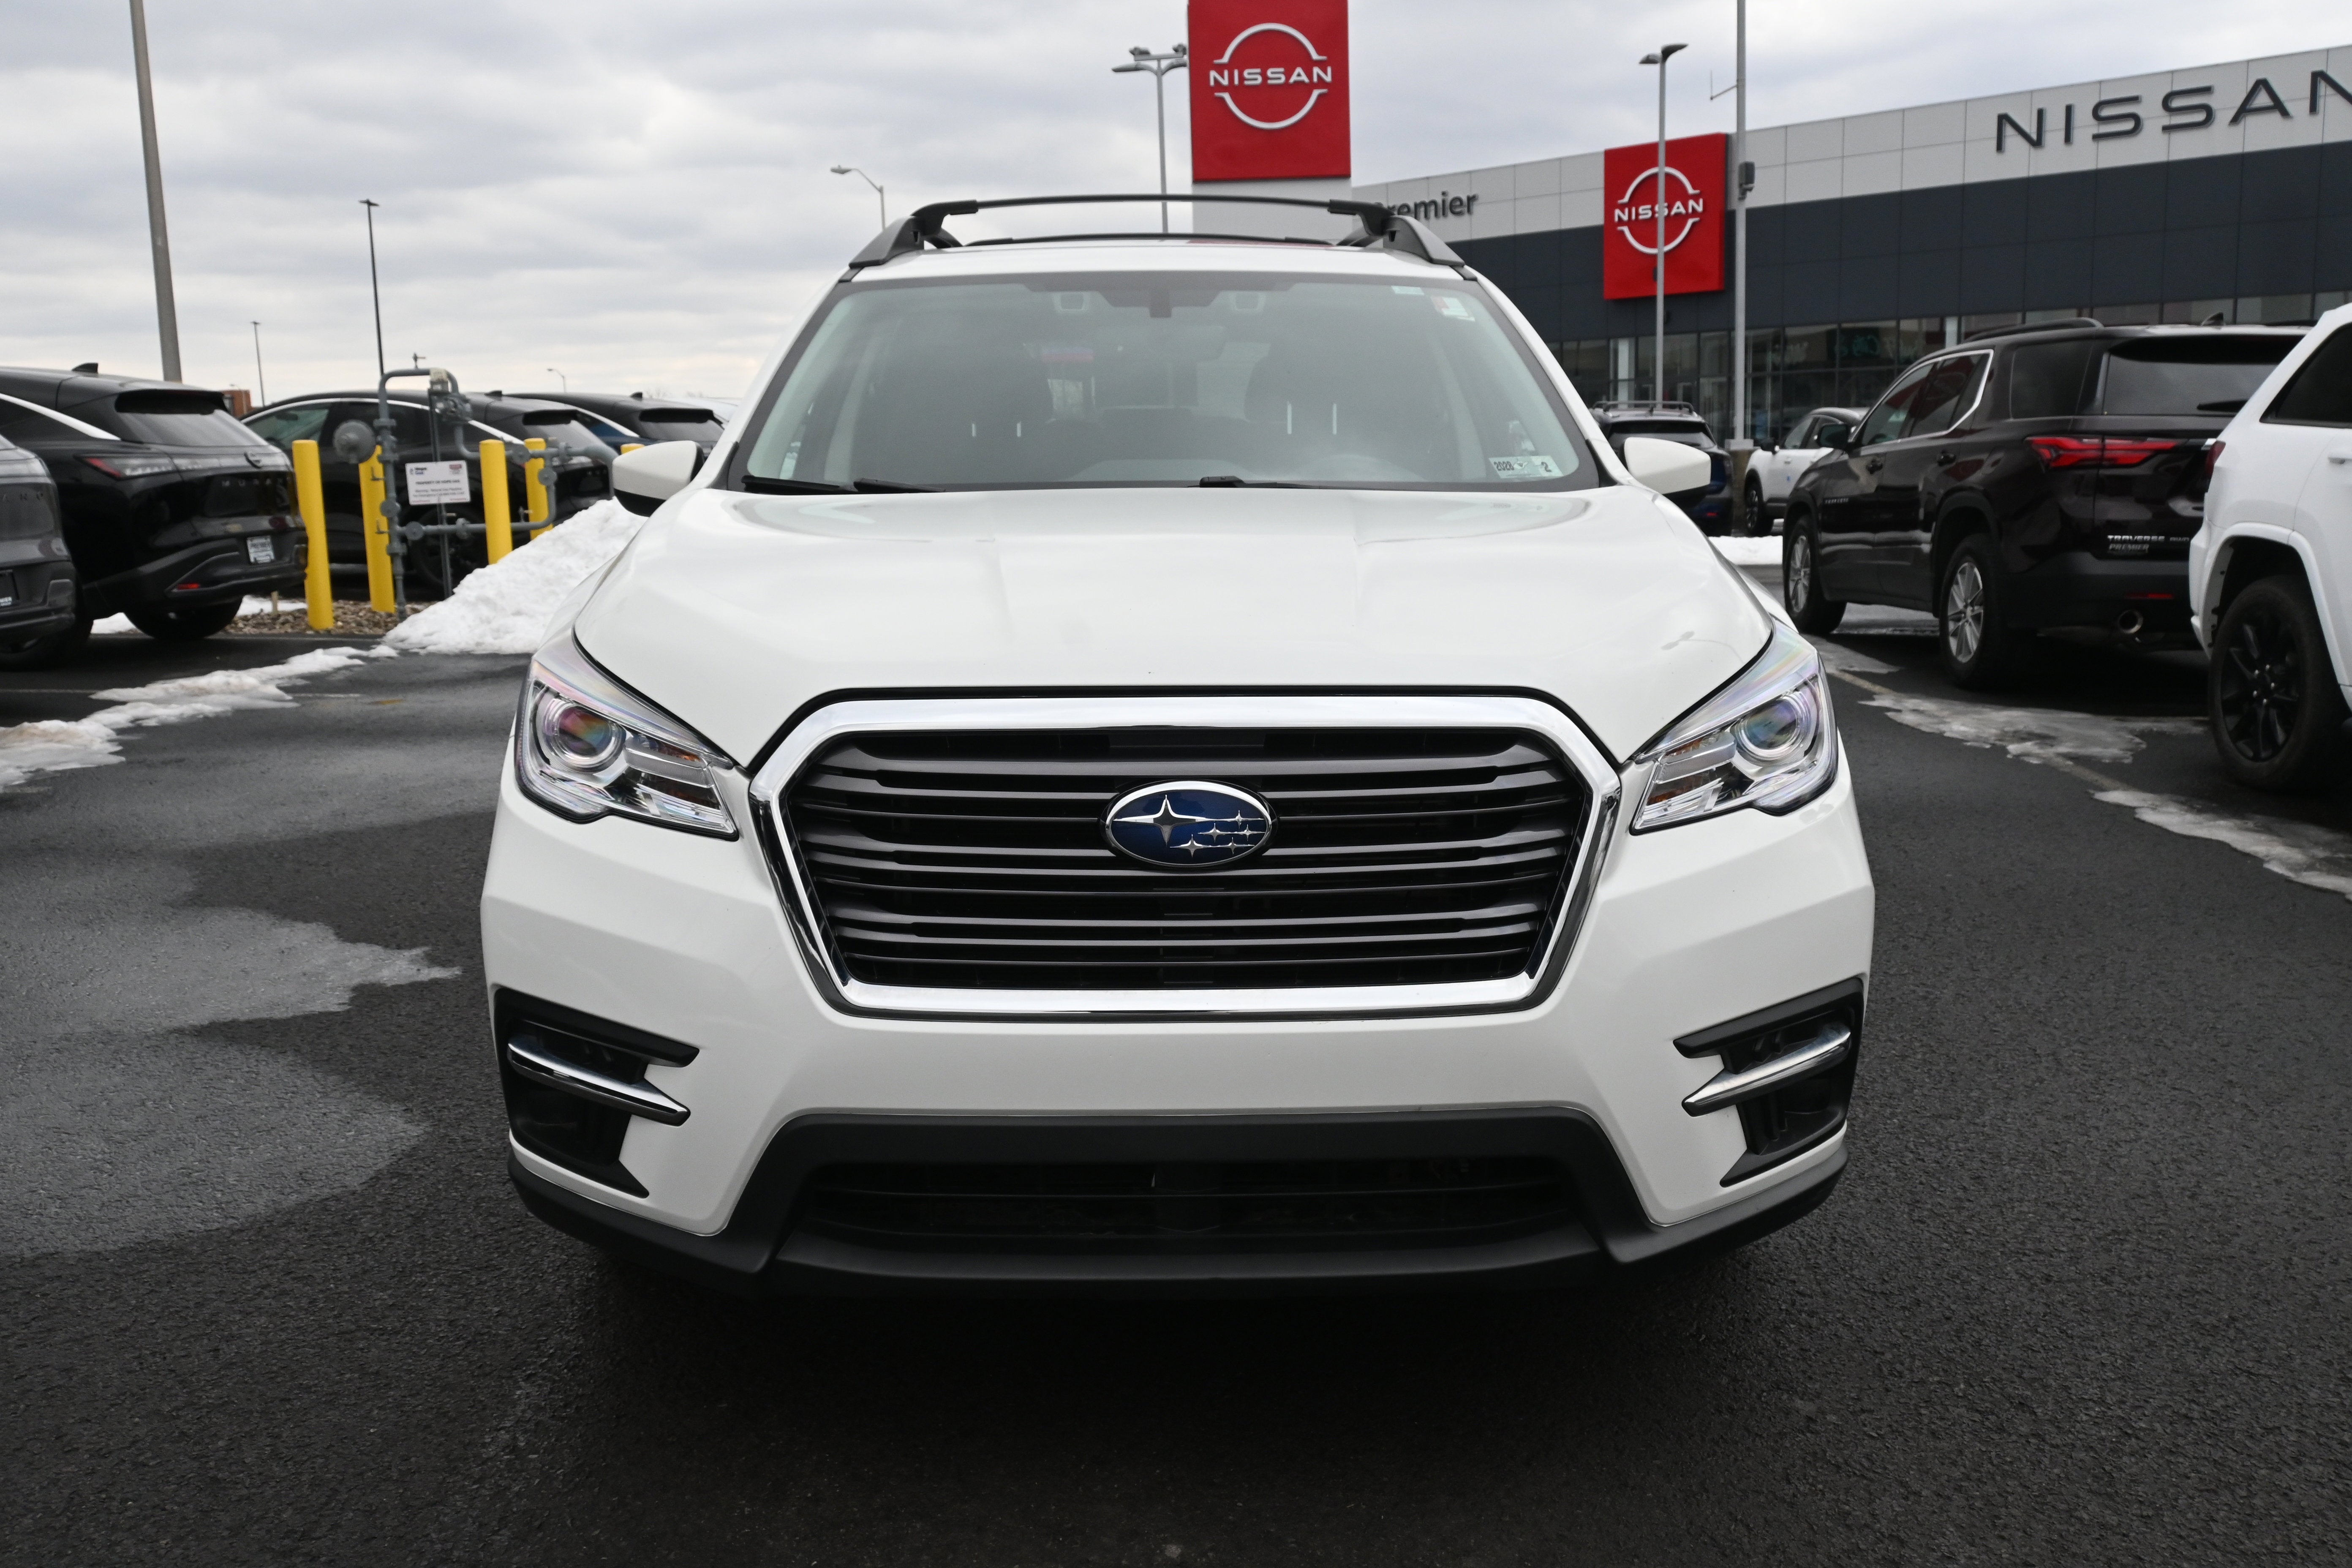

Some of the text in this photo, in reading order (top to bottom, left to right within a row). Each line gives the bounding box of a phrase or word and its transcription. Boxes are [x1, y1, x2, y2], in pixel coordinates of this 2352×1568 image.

[1209, 65, 1332, 87] NISSAN
[1996, 69, 2352, 153] NISSAN
[1614, 198, 1704, 223] NISSAN
[1541, 461, 1552, 472] 2
[2108, 543, 2150, 551] PREMIER
